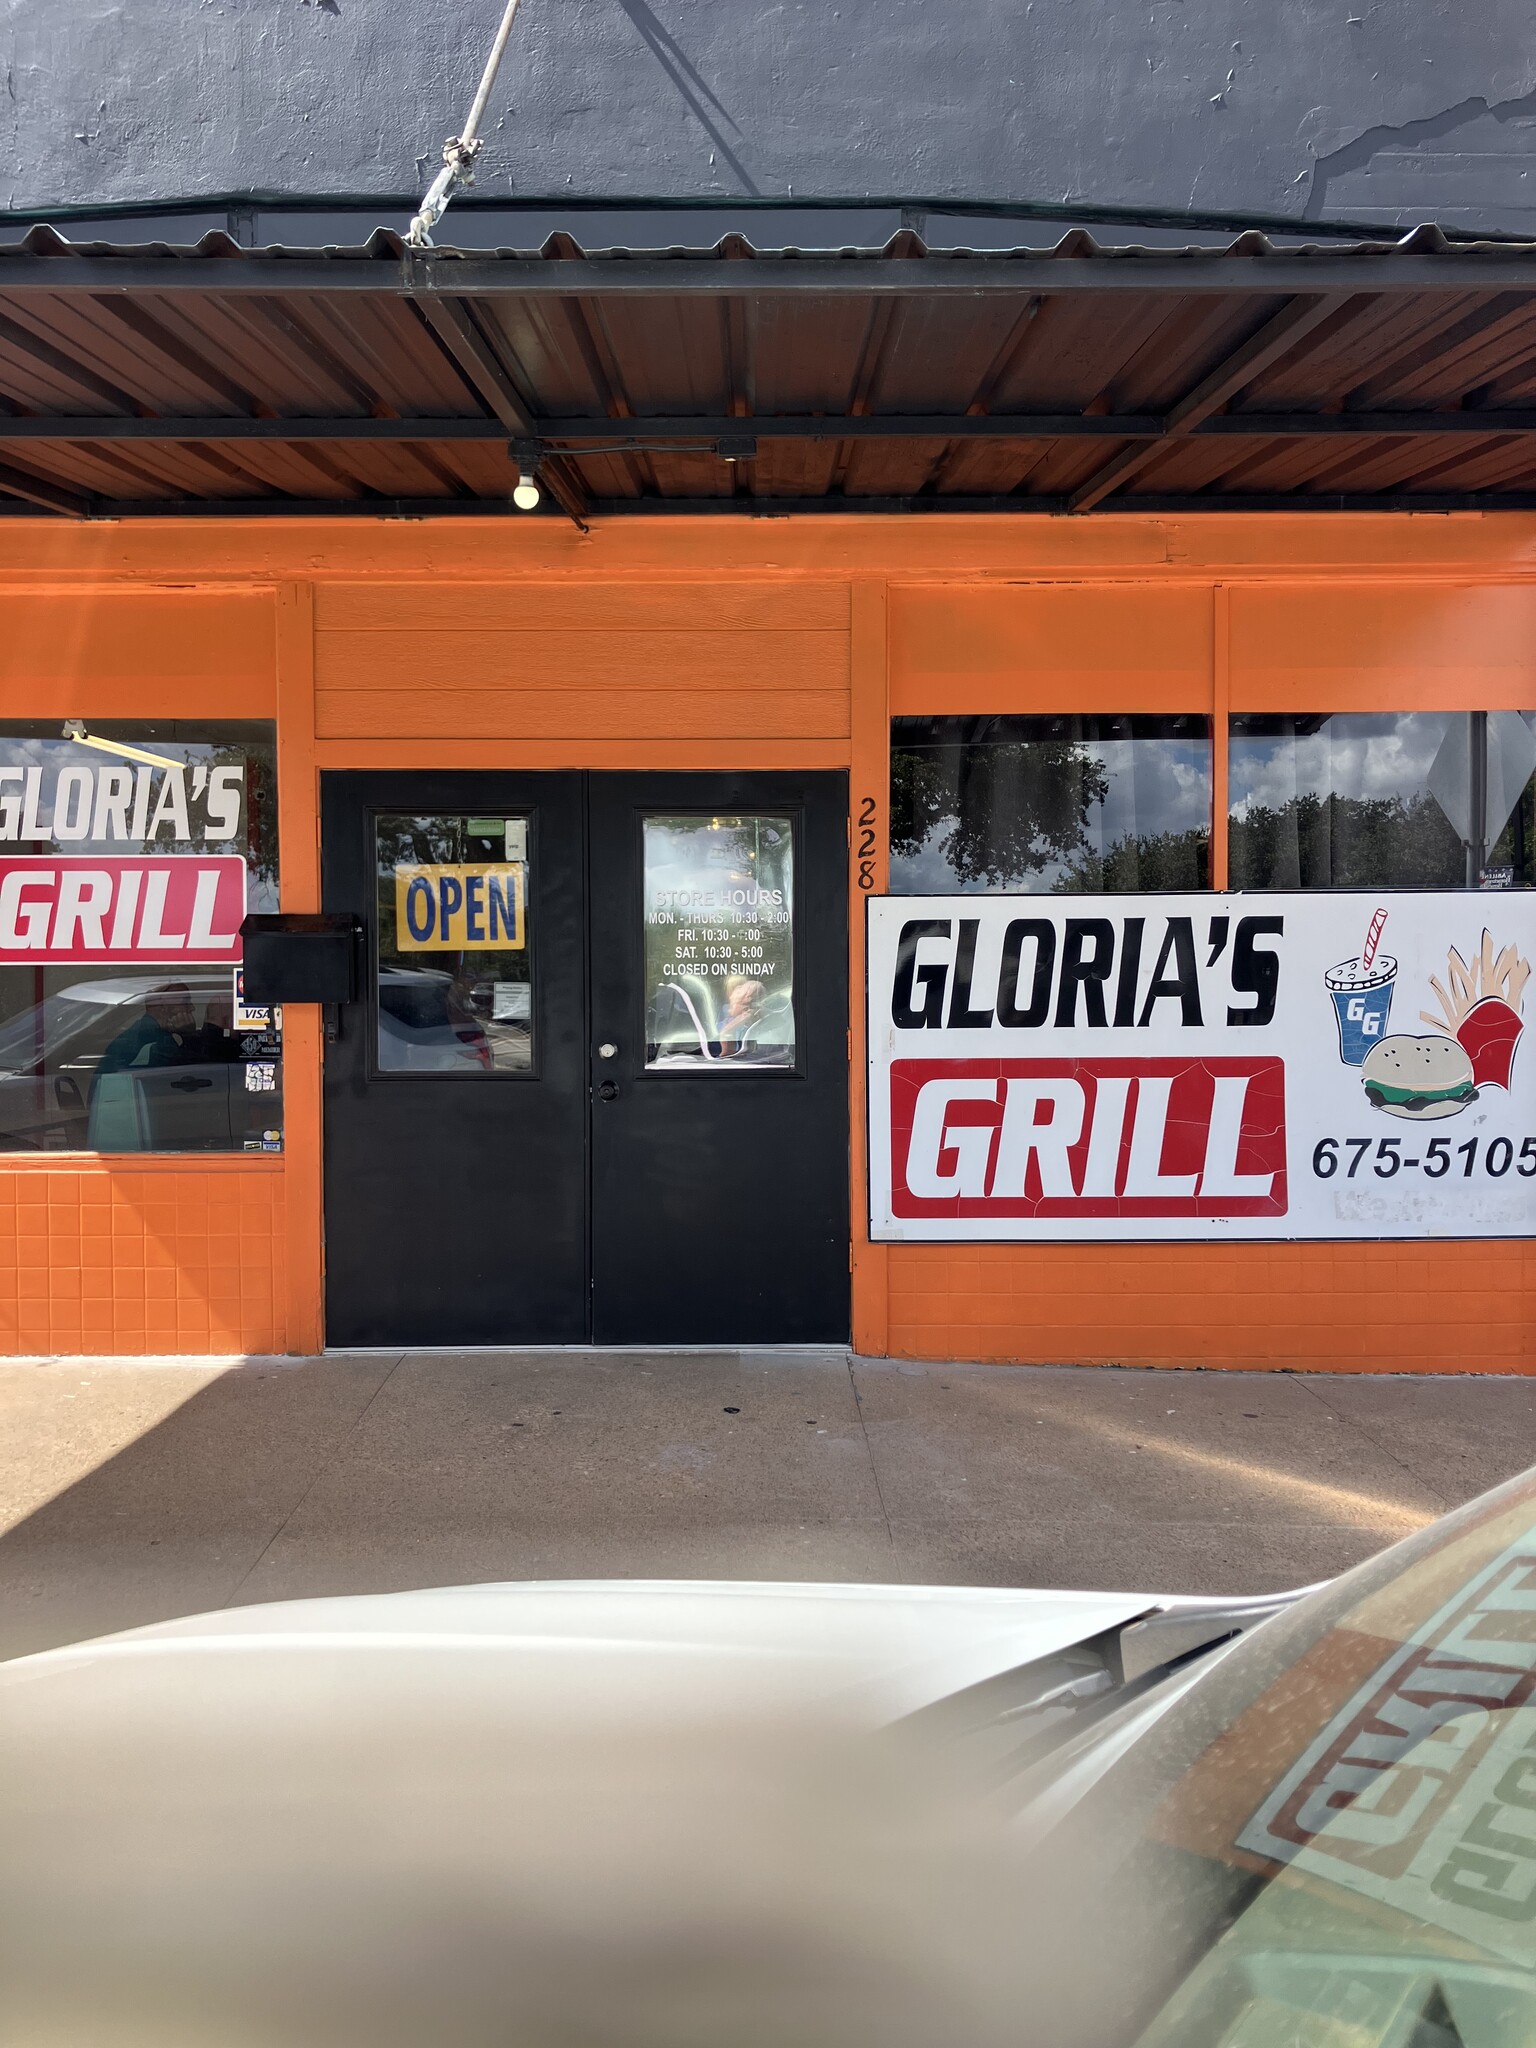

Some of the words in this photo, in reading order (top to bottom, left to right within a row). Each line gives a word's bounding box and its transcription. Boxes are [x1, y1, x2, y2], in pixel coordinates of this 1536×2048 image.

[0, 766, 243, 840] GLORIA'S
[858, 797, 876, 890] 228
[0, 870, 236, 949] GRILL
[406, 876, 517, 942] OPEN
[648, 912, 677, 924] MON.
[688, 912, 724, 924] THURS
[731, 911, 758, 924] 10:30
[767, 911, 789, 924] 2:00
[656, 890, 715, 907] STORE
[721, 889, 783, 906] HOURS
[675, 946, 698, 959] SAT.
[704, 946, 732, 959] 10:30
[741, 946, 763, 959] 5:00
[678, 929, 699, 941] FRI.
[701, 929, 729, 941] 10:30
[663, 963, 709, 976] CLOSED
[711, 963, 728, 976] ON
[730, 962, 776, 976] SUNDAY
[891, 915, 1285, 1030] GLORIA'S
[245, 1009, 270, 1019] VISA
[905, 1077, 1275, 1199] GRILL
[1312, 1136, 1536, 1179] 675-5105
